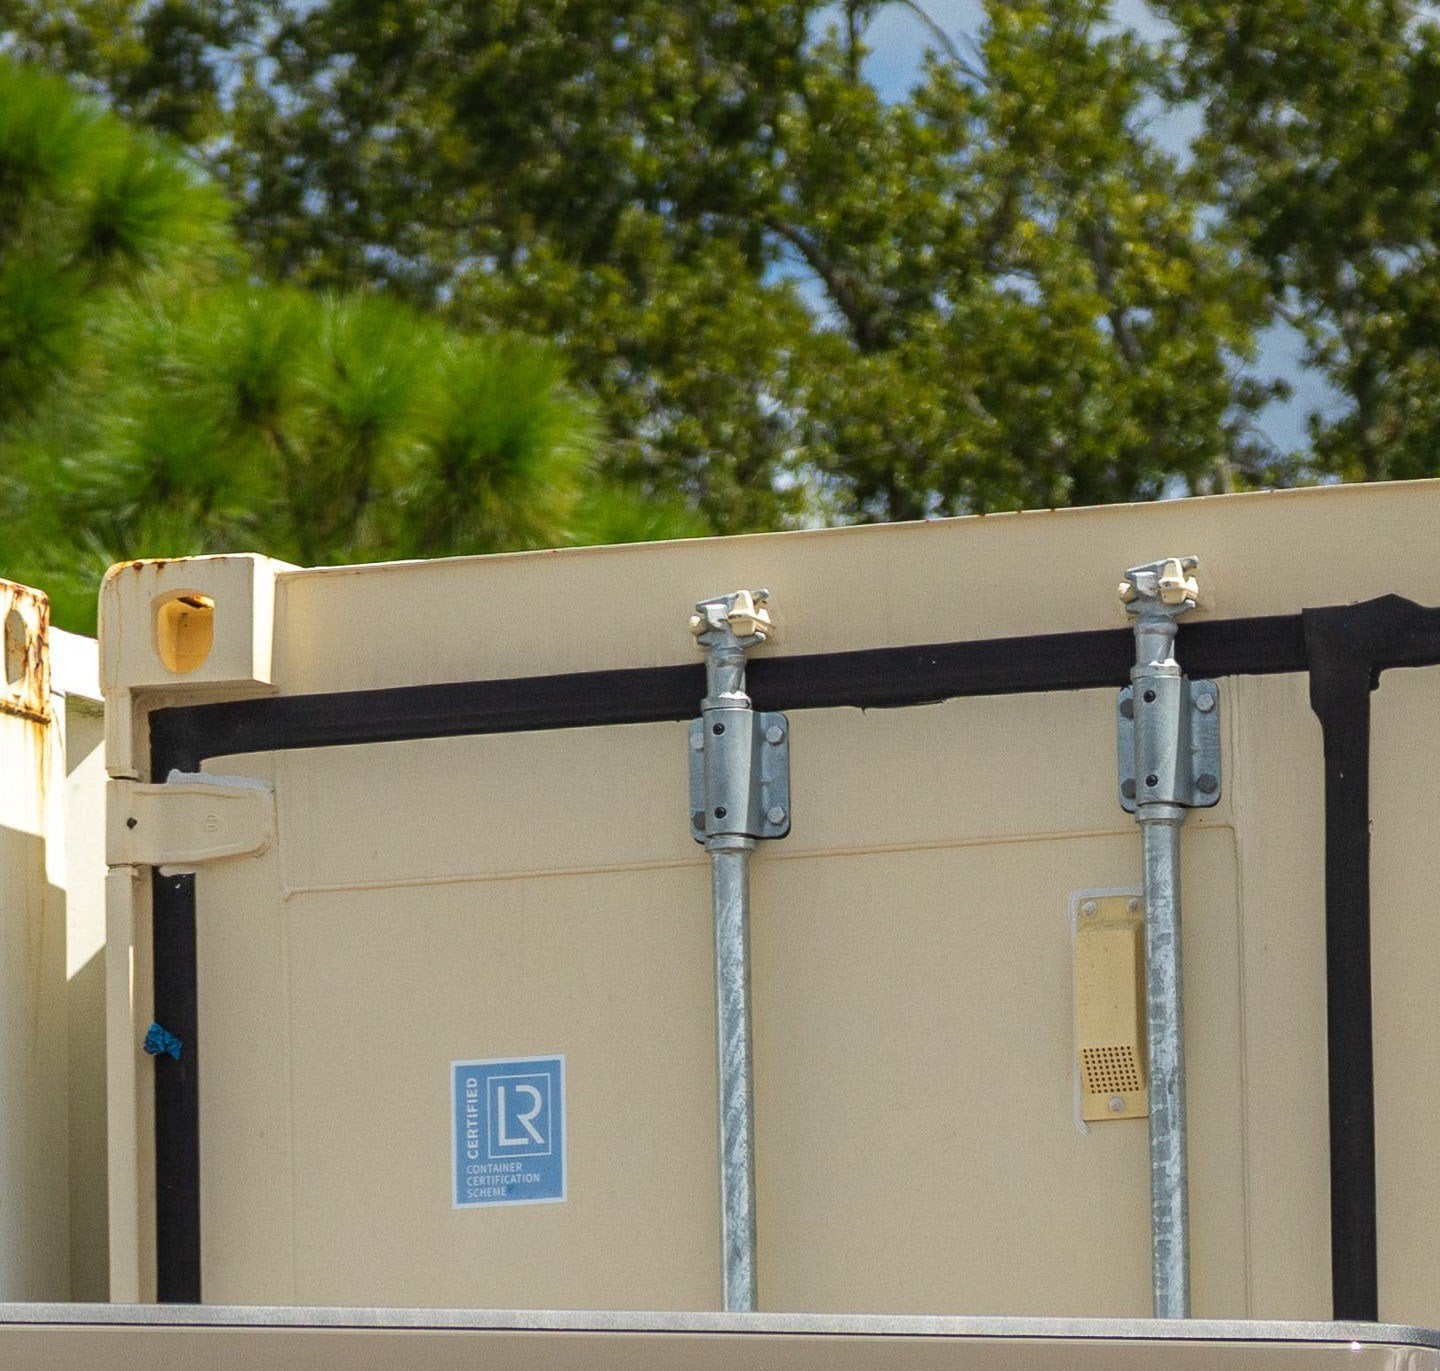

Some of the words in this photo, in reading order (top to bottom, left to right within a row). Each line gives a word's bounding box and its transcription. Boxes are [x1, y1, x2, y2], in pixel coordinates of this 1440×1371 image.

[466, 1077, 478, 1159] CERTIFIED
[497, 1084, 546, 1147] LR
[466, 1162, 522, 1174] CONTAINER
[466, 1173, 540, 1187] CERTIFICATION
[466, 1186, 507, 1199] SCHEME
